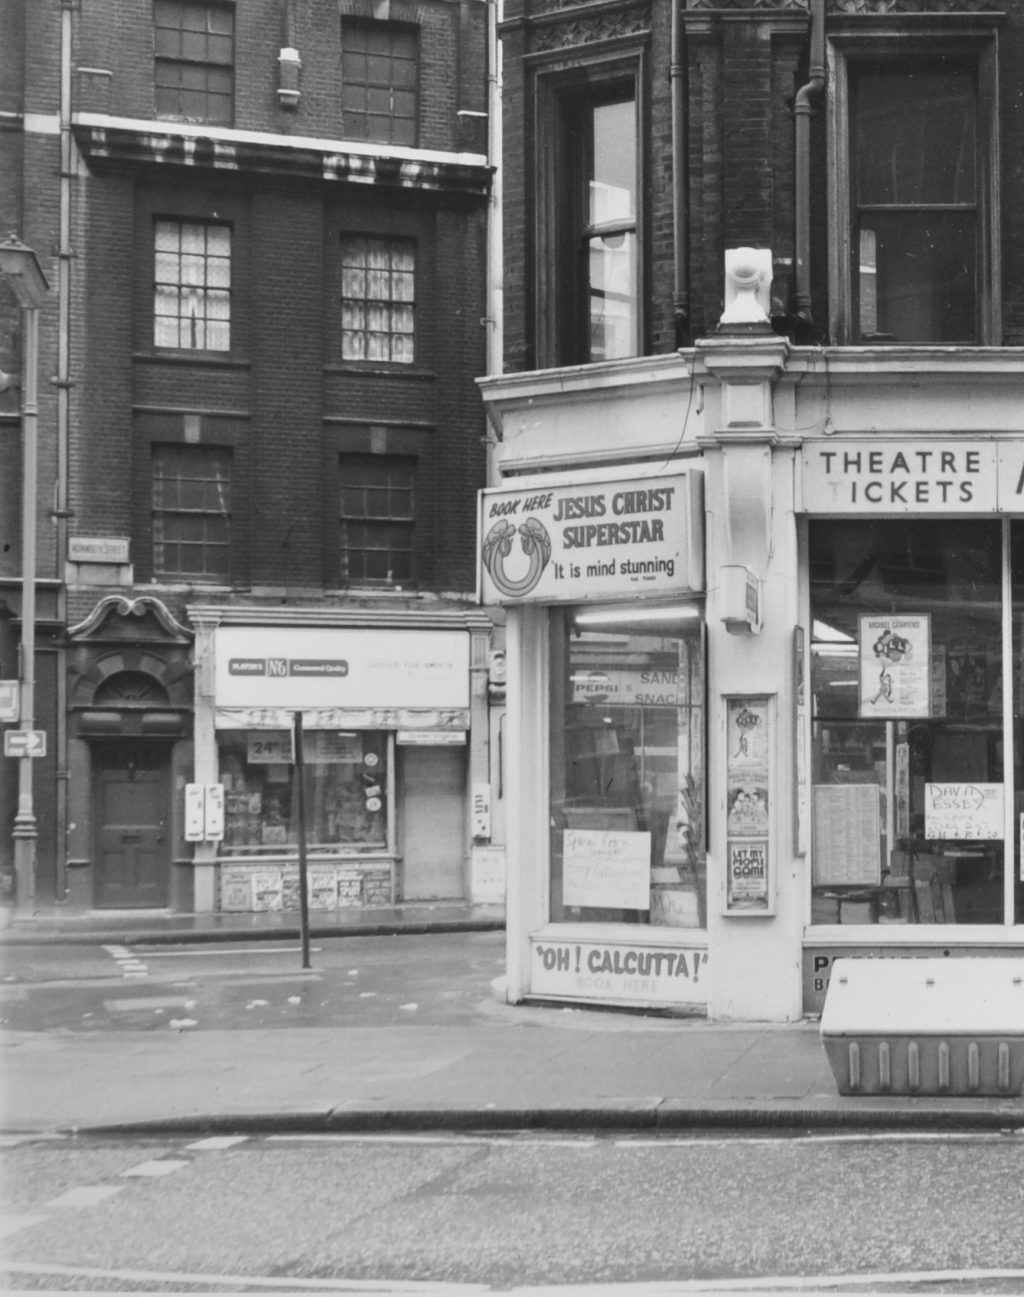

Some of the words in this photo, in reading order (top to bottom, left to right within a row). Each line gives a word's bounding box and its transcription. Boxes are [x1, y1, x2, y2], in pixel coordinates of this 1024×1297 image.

[820, 452, 980, 474] THEATRE
[827, 481, 974, 504] TICKETS
[489, 499, 521, 518] BOOK
[522, 492, 554, 512] HERE
[553, 494, 607, 522] JESUS
[612, 487, 675, 516] CHRIST
[563, 519, 665, 550] SUPERSTAR
[569, 562, 581, 579] is
[586, 557, 616, 577] mind
[928, 785, 985, 803] DAVID
[932, 799, 986, 811] ESSEX
[733, 858, 764, 867] PEOPLE
[733, 866, 764, 876] COME
[577, 976, 613, 991] BOOK
[624, 977, 659, 993] HERE
